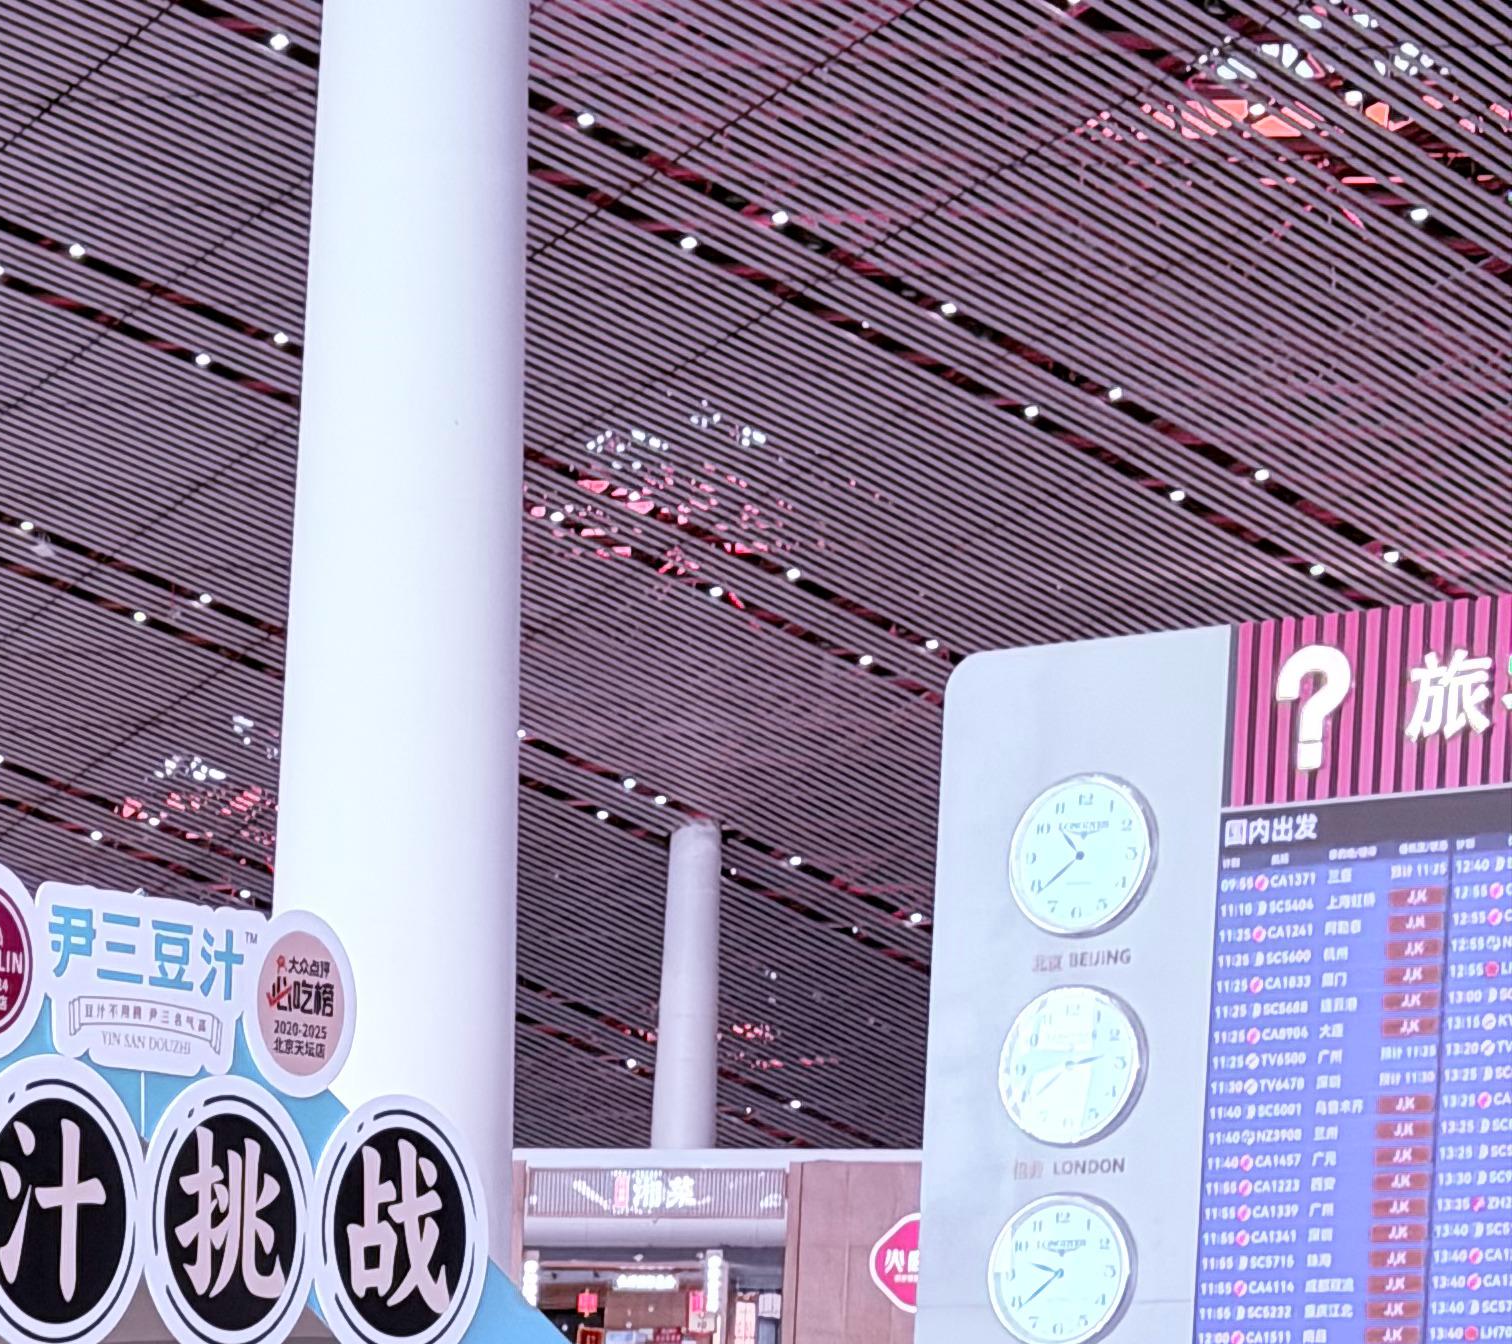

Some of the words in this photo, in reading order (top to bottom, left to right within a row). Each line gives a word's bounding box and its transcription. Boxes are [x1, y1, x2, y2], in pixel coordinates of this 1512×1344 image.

[1405, 648, 1512, 742] 旅
[1224, 813, 1318, 848] 国内出发
[1270, 871, 1316, 888] CA1371
[245, 932, 258, 945] TM
[48, 904, 244, 1001] 尹三豆汁
[1069, 948, 1132, 968] BEIJING
[288, 956, 330, 979] 大众点评
[267, 976, 335, 1017] 必吃榜
[274, 1020, 327, 1040] 2020-2025
[102, 1031, 120, 1046] YIN
[124, 1034, 145, 1049] SAN
[149, 1037, 192, 1055] DOUZHI
[273, 1038, 326, 1059] 北京天坛店
[1317, 1049, 1343, 1064] 广州
[1053, 1158, 1126, 1175] LONDON
[1309, 1202, 1334, 1217] 广州
